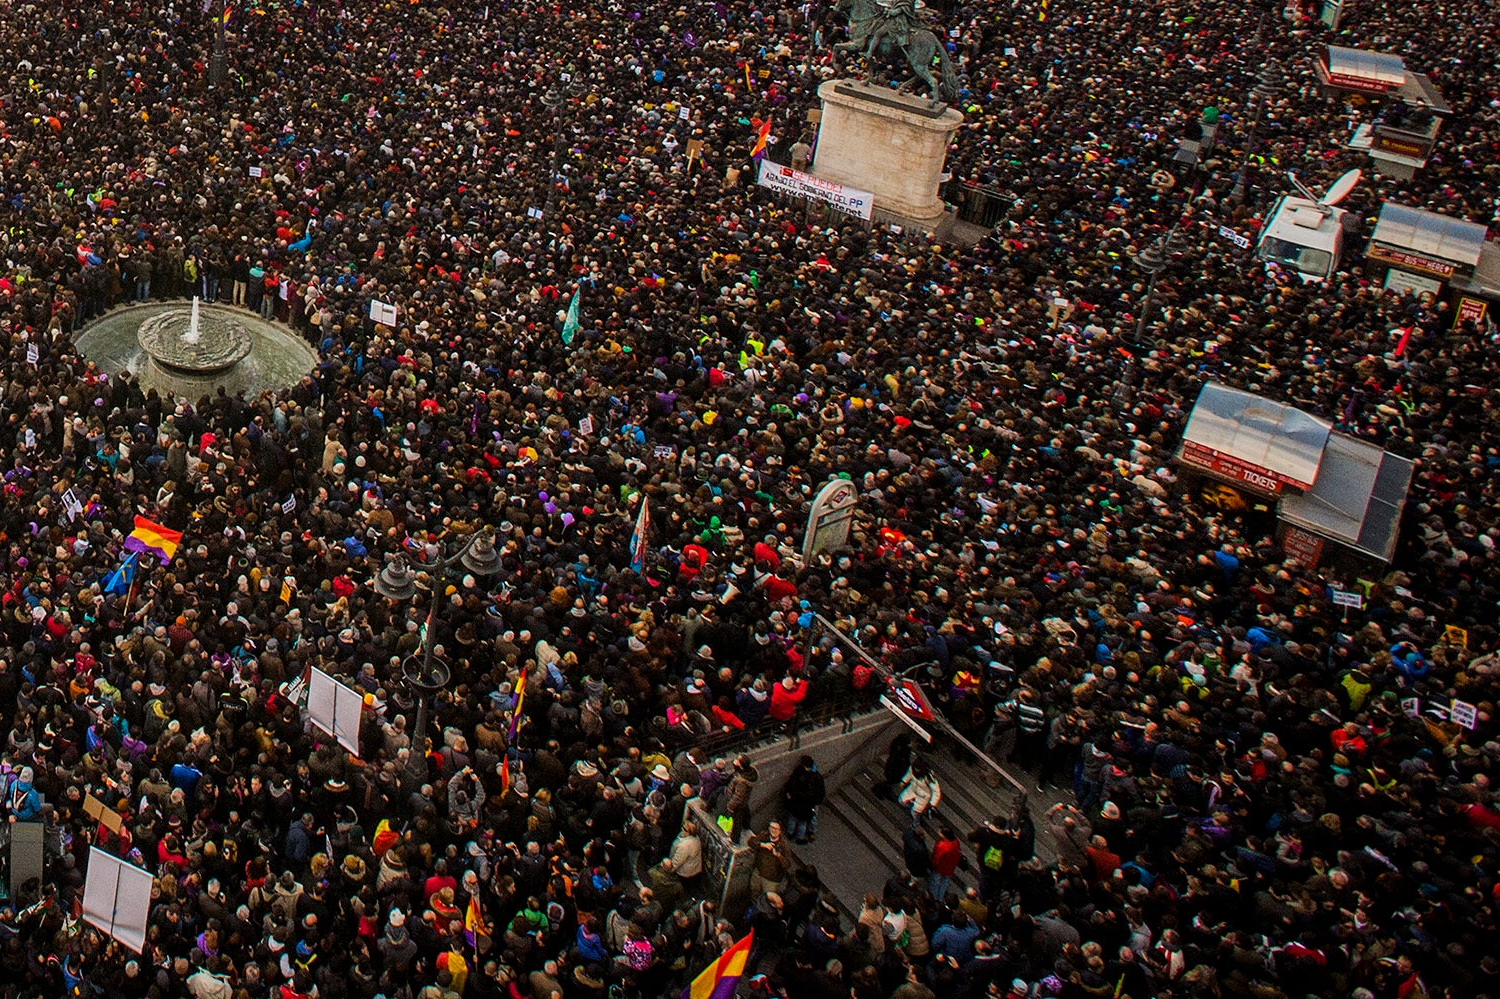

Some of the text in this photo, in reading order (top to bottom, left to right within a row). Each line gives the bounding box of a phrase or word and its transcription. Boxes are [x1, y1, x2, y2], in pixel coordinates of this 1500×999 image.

[765, 172, 864, 209] ABAJO EL GOBIERNO DEL PP
[1243, 470, 1278, 490] TICKETS
